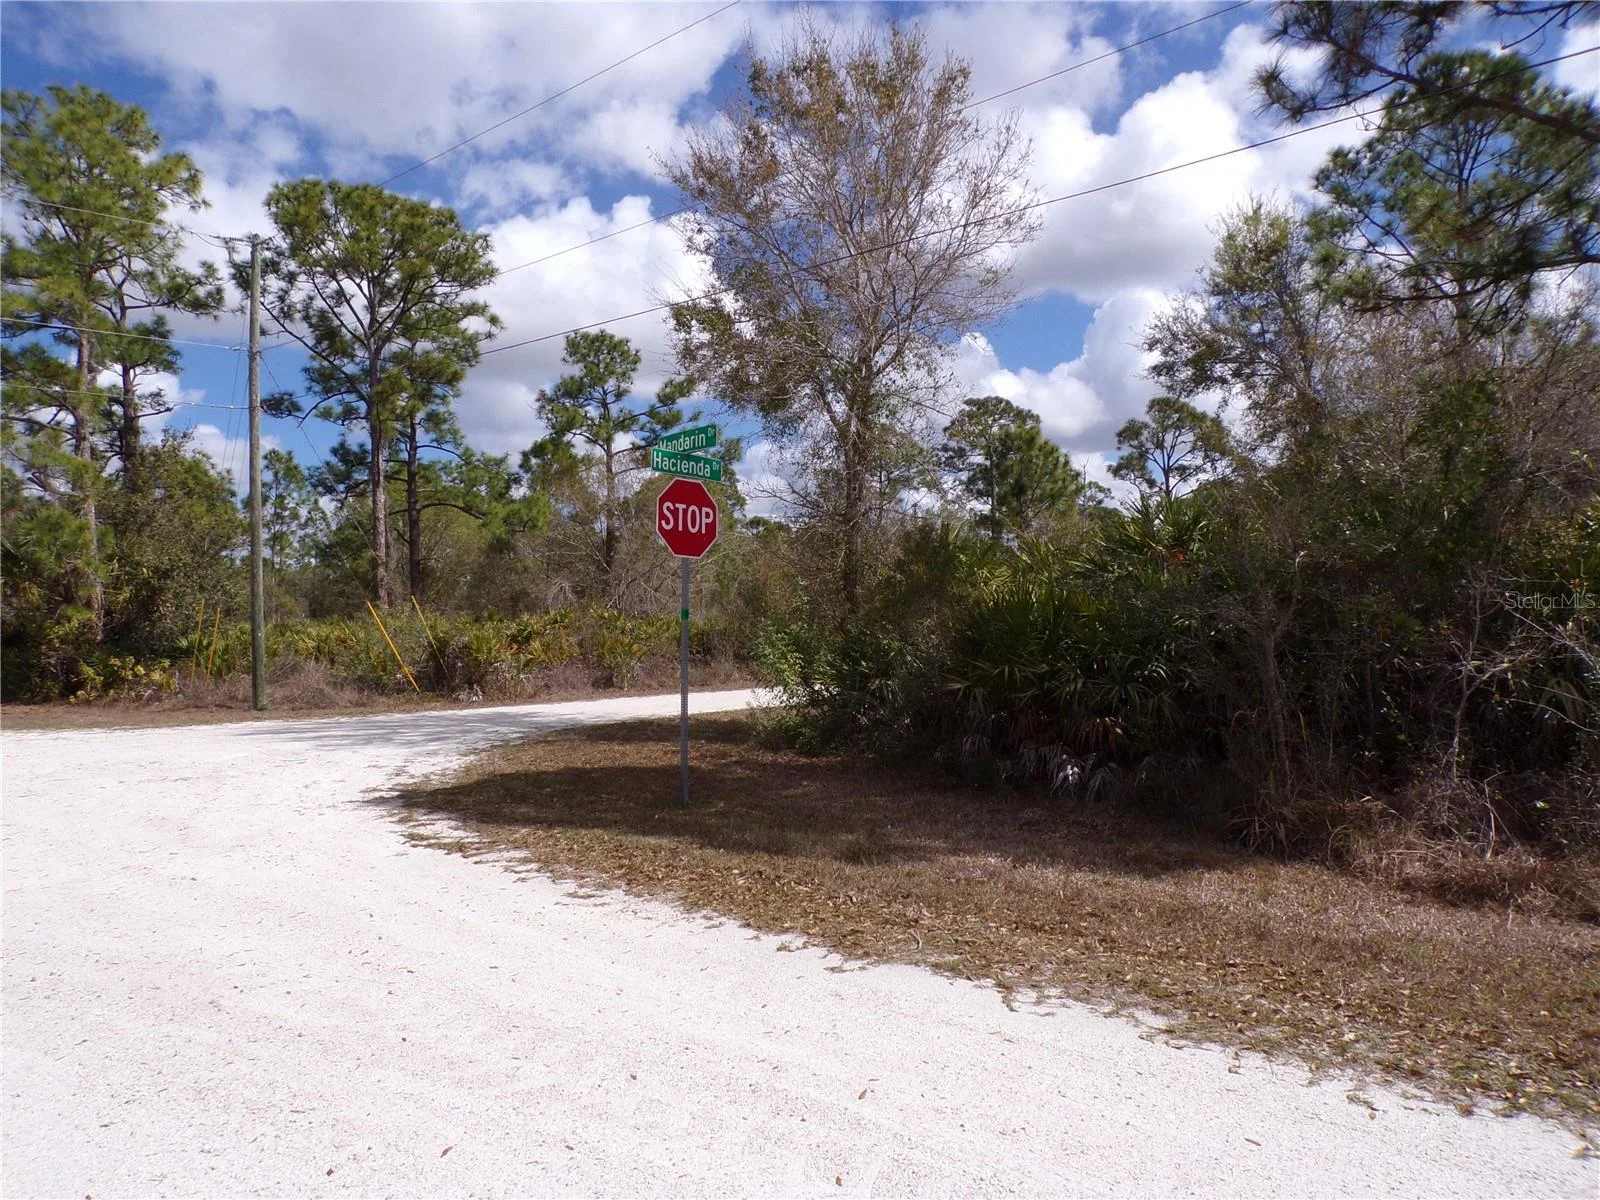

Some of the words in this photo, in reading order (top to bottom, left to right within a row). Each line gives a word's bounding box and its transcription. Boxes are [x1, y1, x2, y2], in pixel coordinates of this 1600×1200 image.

[660, 430, 706, 453] Mandarin
[708, 427, 716, 437] Dr
[653, 451, 711, 477] Hacienda
[712, 461, 720, 471] Dr
[661, 501, 714, 535] STOP
